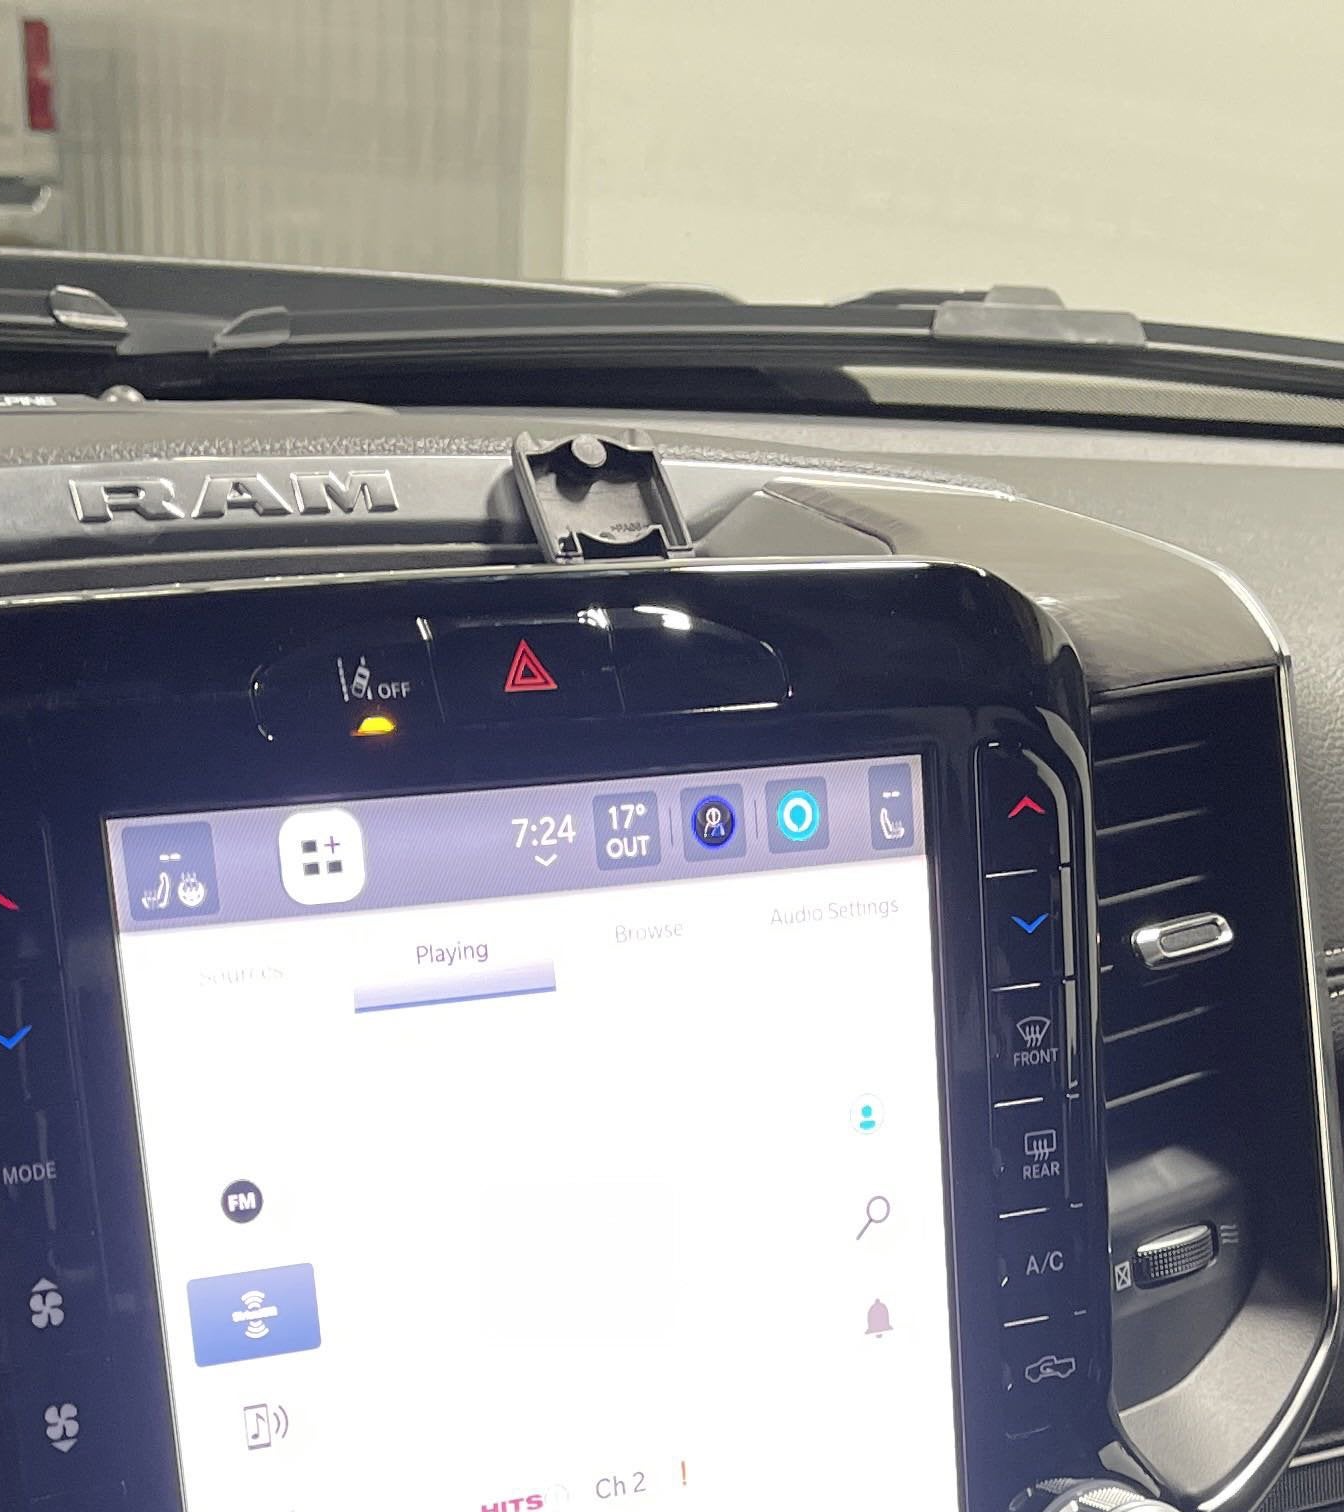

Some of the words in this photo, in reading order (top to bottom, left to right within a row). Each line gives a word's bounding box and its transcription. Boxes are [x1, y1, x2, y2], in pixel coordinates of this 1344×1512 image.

[67, 469, 400, 524] RAM
[377, 681, 411, 700] OFF
[608, 803, 647, 831] 17°
[511, 814, 577, 849] 7:24
[605, 835, 651, 861] OUT
[770, 904, 823, 926] Audio
[828, 898, 900, 919] Settings
[614, 918, 684, 944] Browse
[415, 940, 489, 966] Playing
[1013, 1048, 1059, 1066] FRONT
[2, 1161, 57, 1186] MODE
[1022, 1161, 1060, 1180] REAR
[227, 1193, 257, 1212] FM
[1025, 1252, 1064, 1276] A/C
[594, 1474, 626, 1501] Ch
[632, 1471, 647, 1494] 2
